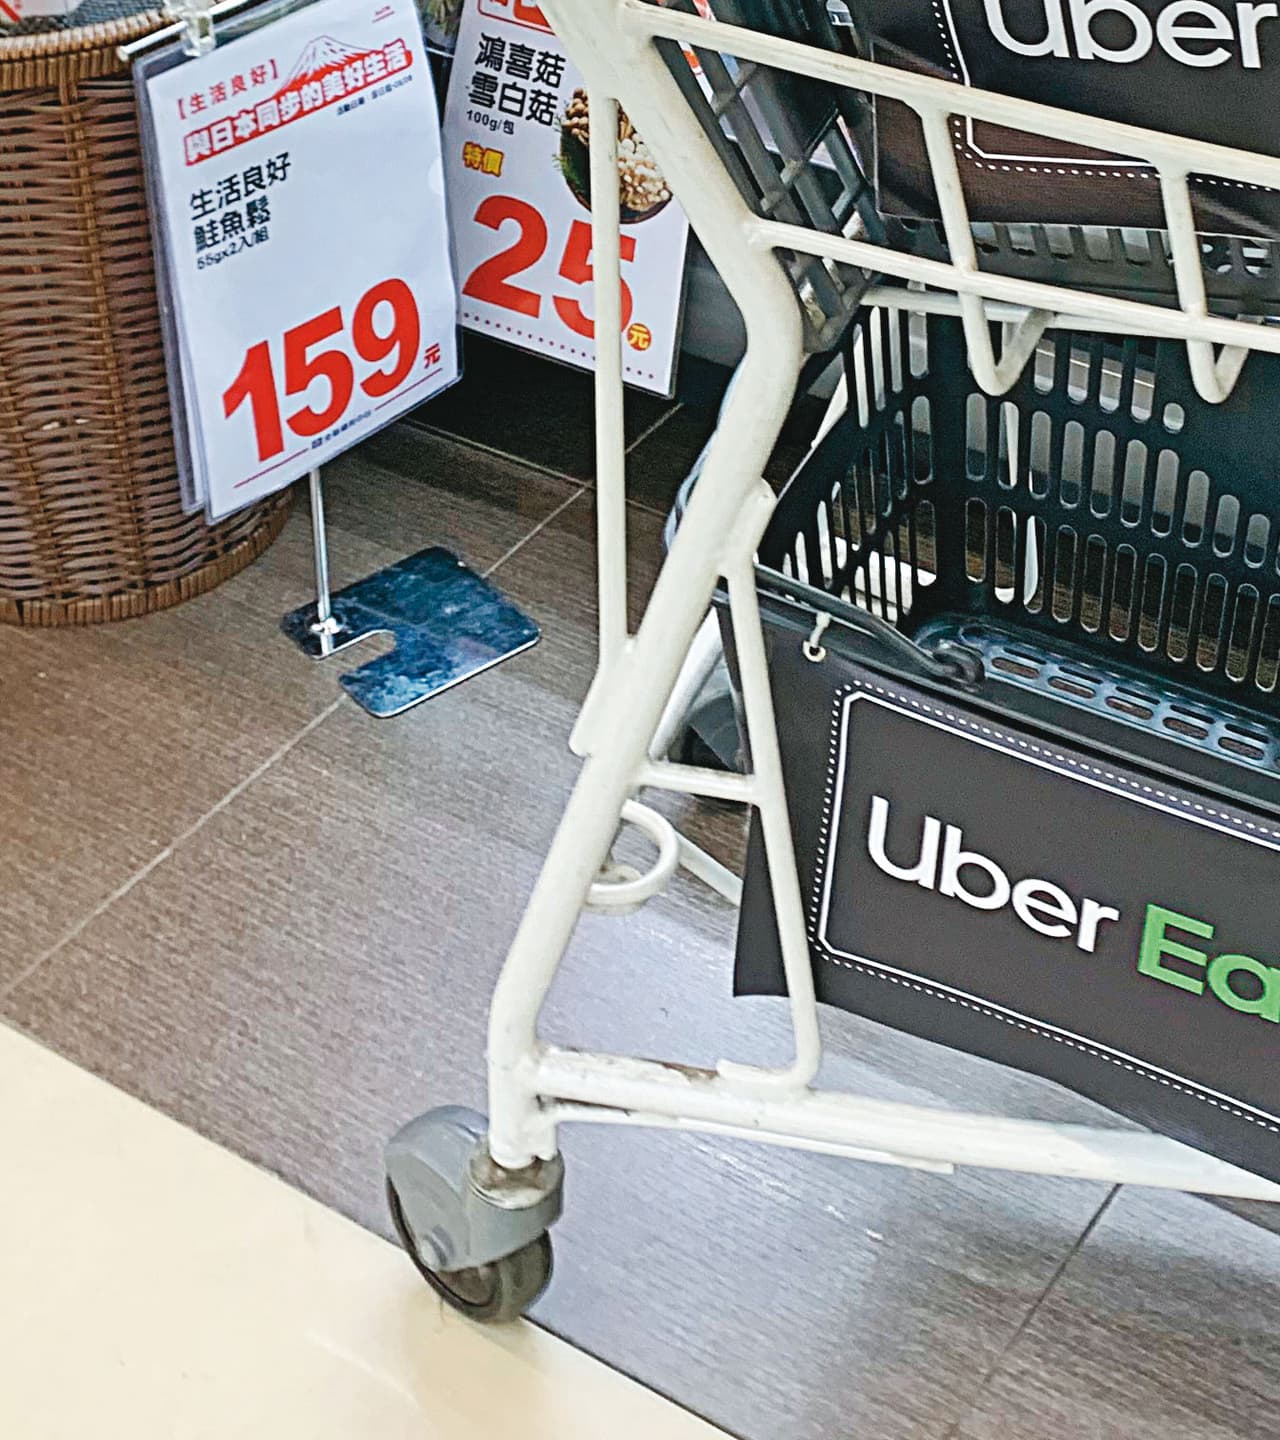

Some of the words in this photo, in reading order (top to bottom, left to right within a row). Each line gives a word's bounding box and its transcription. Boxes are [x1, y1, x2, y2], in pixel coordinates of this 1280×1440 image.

[474, 32, 566, 89] 鴻喜菇
[184, 40, 412, 164] 與日本同步的美好生活
[468, 71, 558, 127] 雪白菇
[190, 152, 291, 221] 生活良好
[463, 141, 504, 177] 特價
[194, 195, 271, 253] 鮭魚鬆
[462, 194, 636, 340] 25
[424, 343, 441, 369] 元
[629, 324, 649, 350] 元
[222, 278, 420, 463] 159
[867, 796, 1119, 952] Uber
